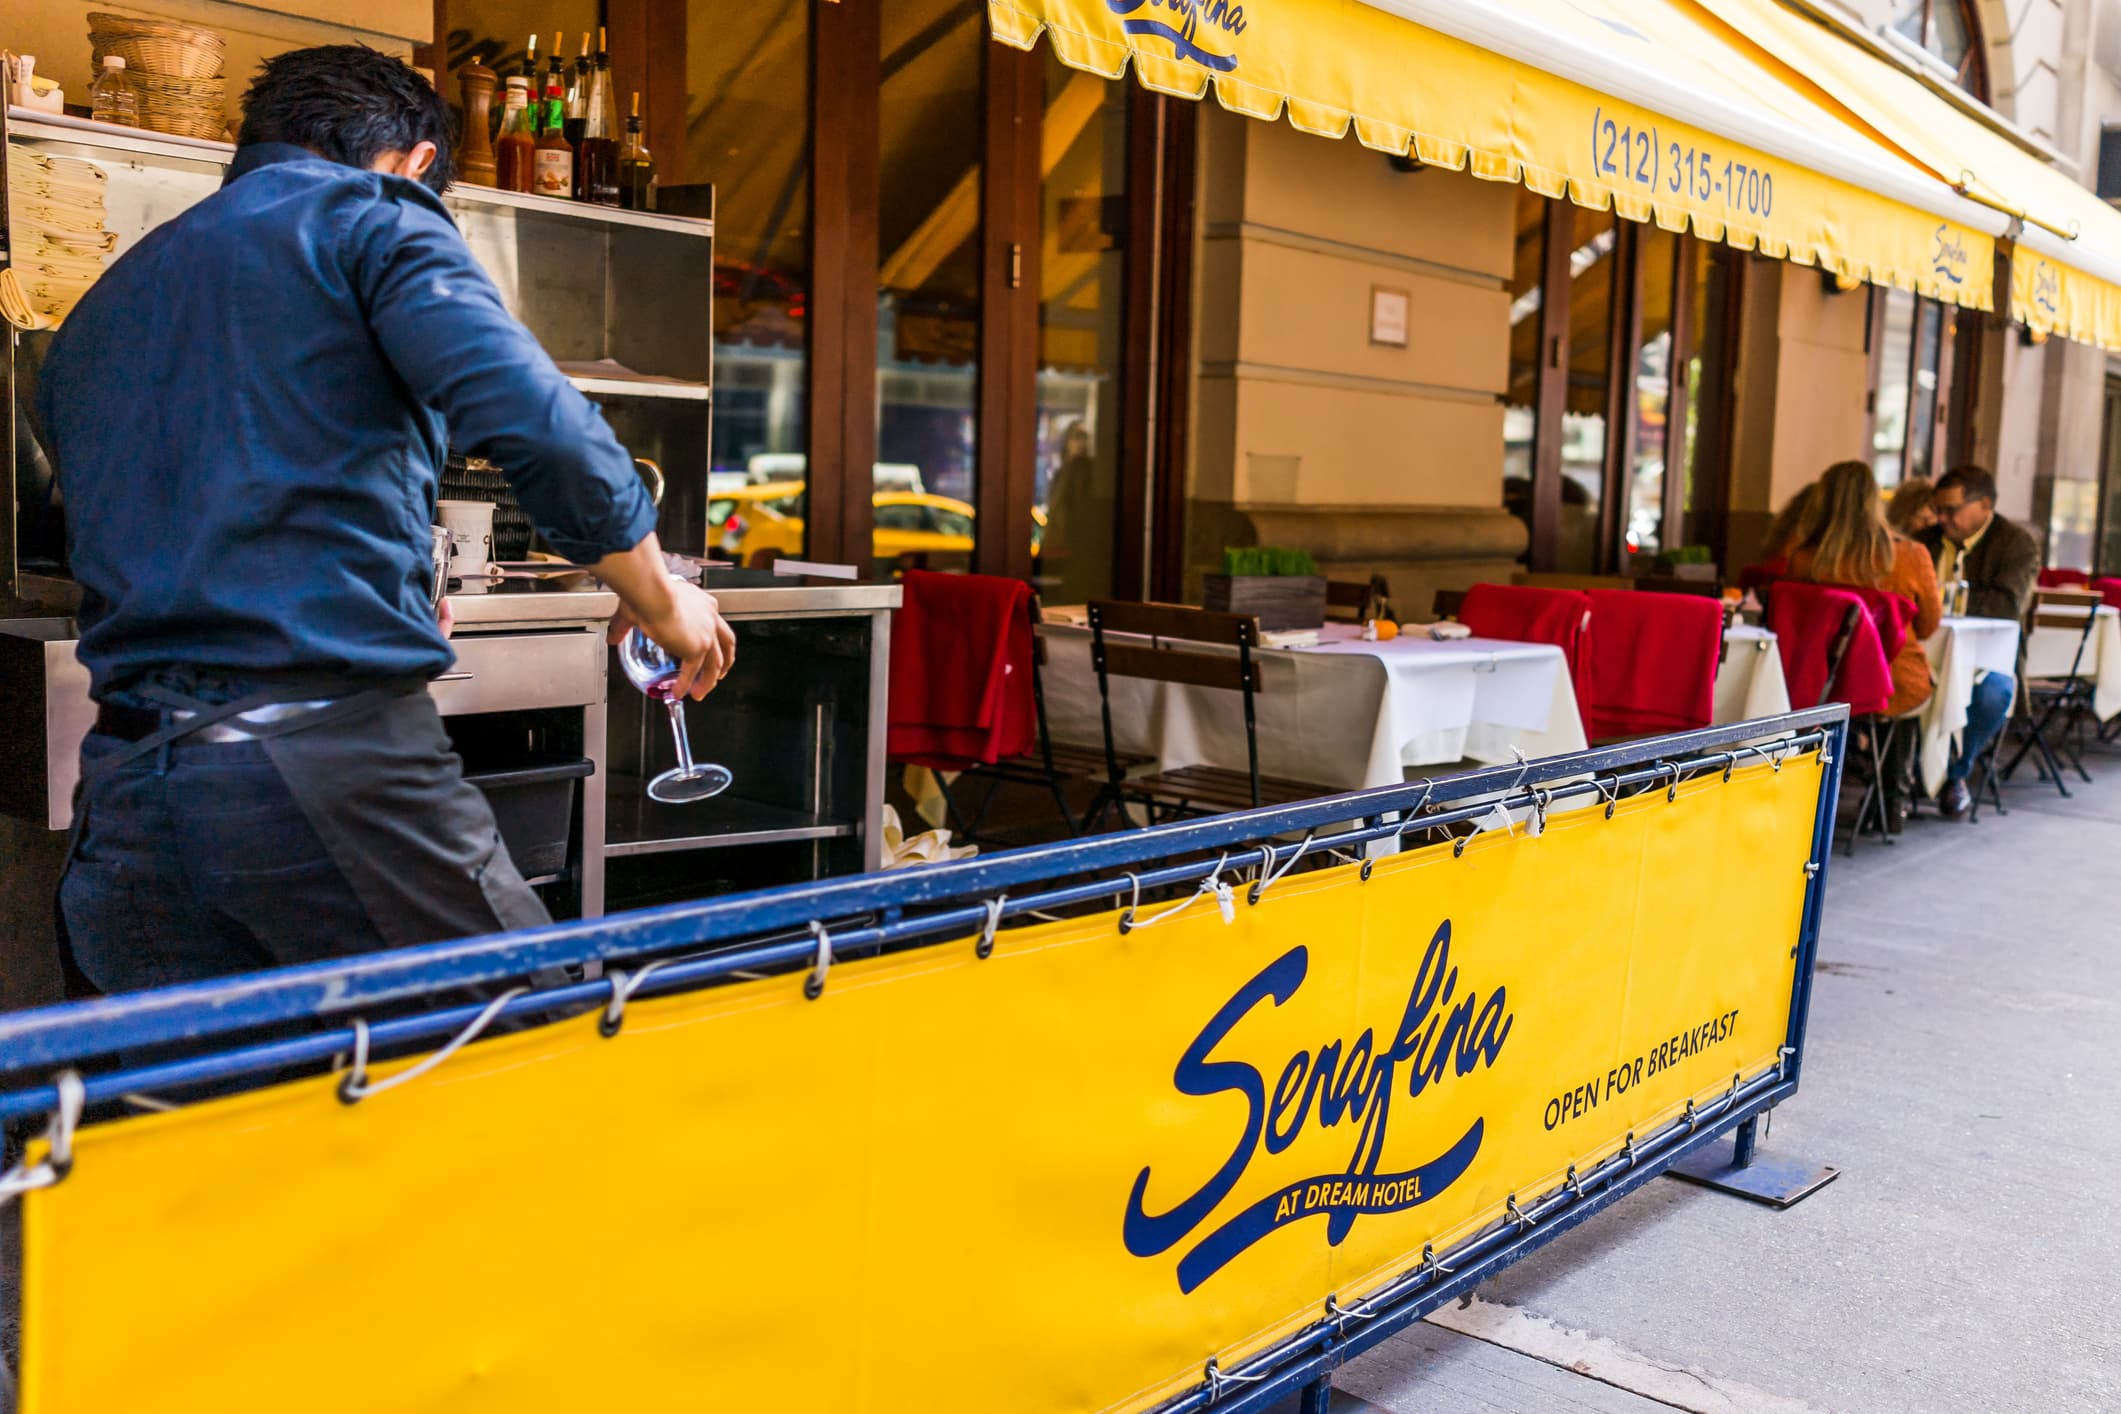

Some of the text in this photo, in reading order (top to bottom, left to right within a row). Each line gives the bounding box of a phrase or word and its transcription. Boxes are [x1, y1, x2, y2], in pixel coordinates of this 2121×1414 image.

[1592, 107, 1772, 218] (212) 315-1700
[1123, 918, 1514, 1258] Serafina
[1544, 1009, 1739, 1132] OPEN FOR BREAKFAST
[1274, 1175, 1422, 1222] AT DREAM HOTEL
